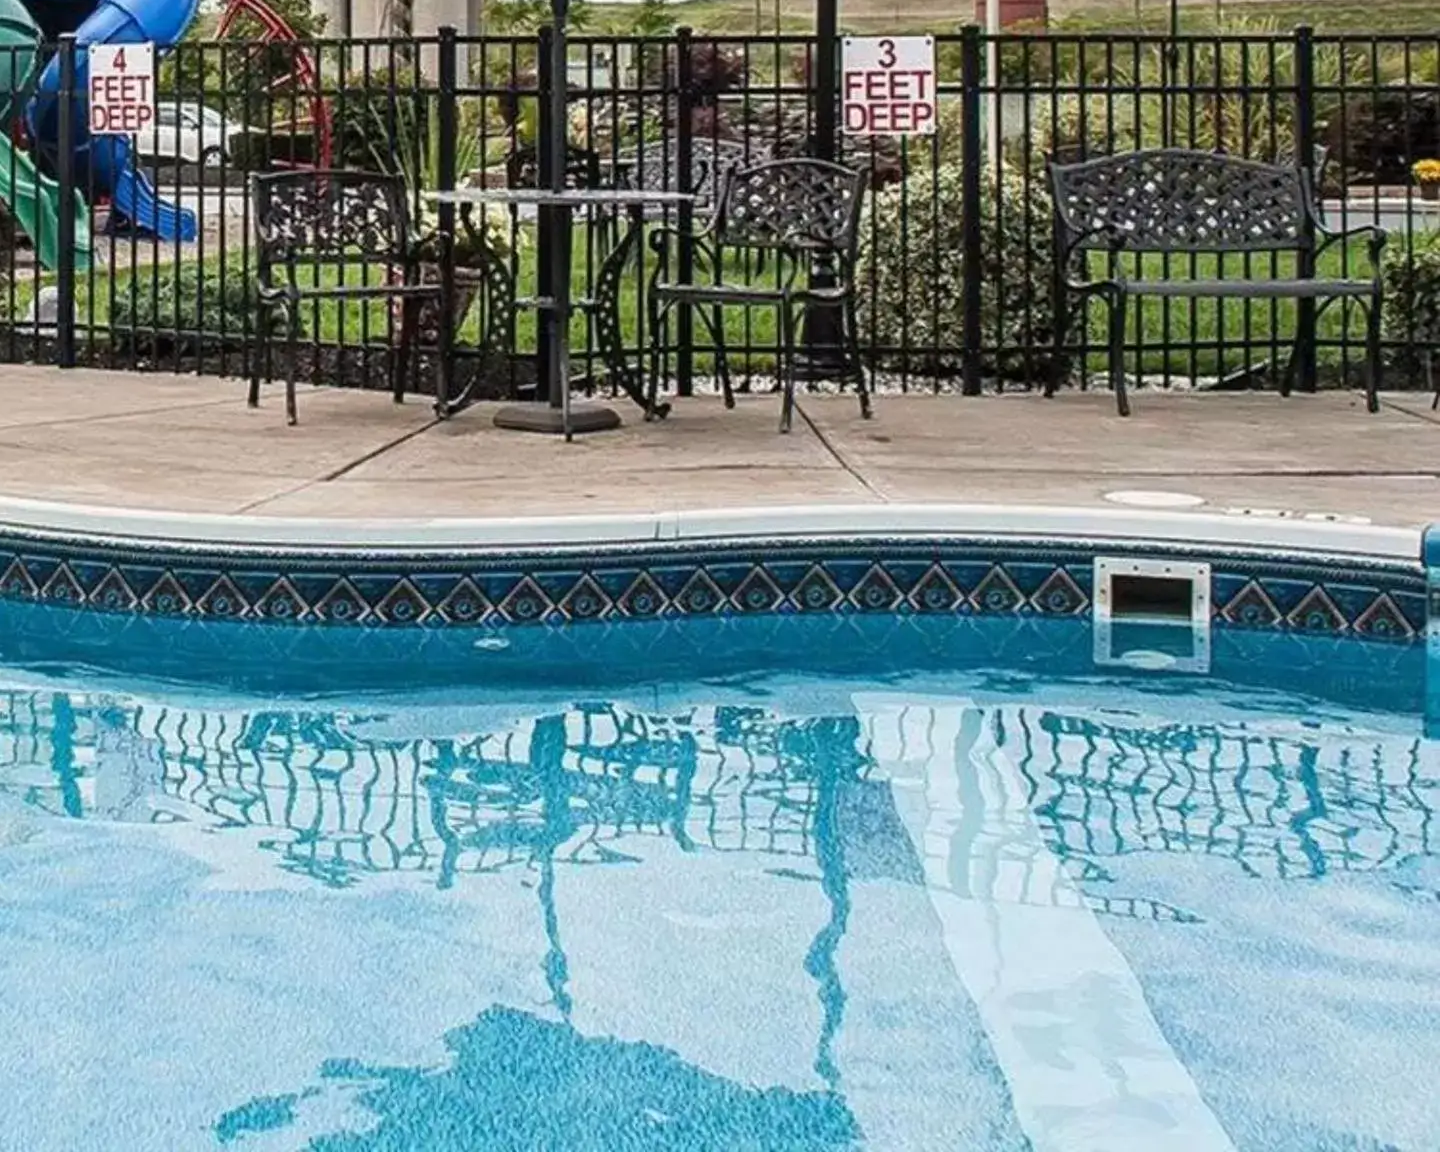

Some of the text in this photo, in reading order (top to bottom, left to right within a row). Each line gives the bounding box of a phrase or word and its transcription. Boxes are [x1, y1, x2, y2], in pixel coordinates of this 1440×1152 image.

[112, 46, 127, 73] 4
[877, 39, 897, 69] 3
[91, 75, 150, 102] FEET
[845, 71, 932, 100] FEET
[91, 104, 152, 131] DEEP
[845, 102, 932, 131] DEEP
